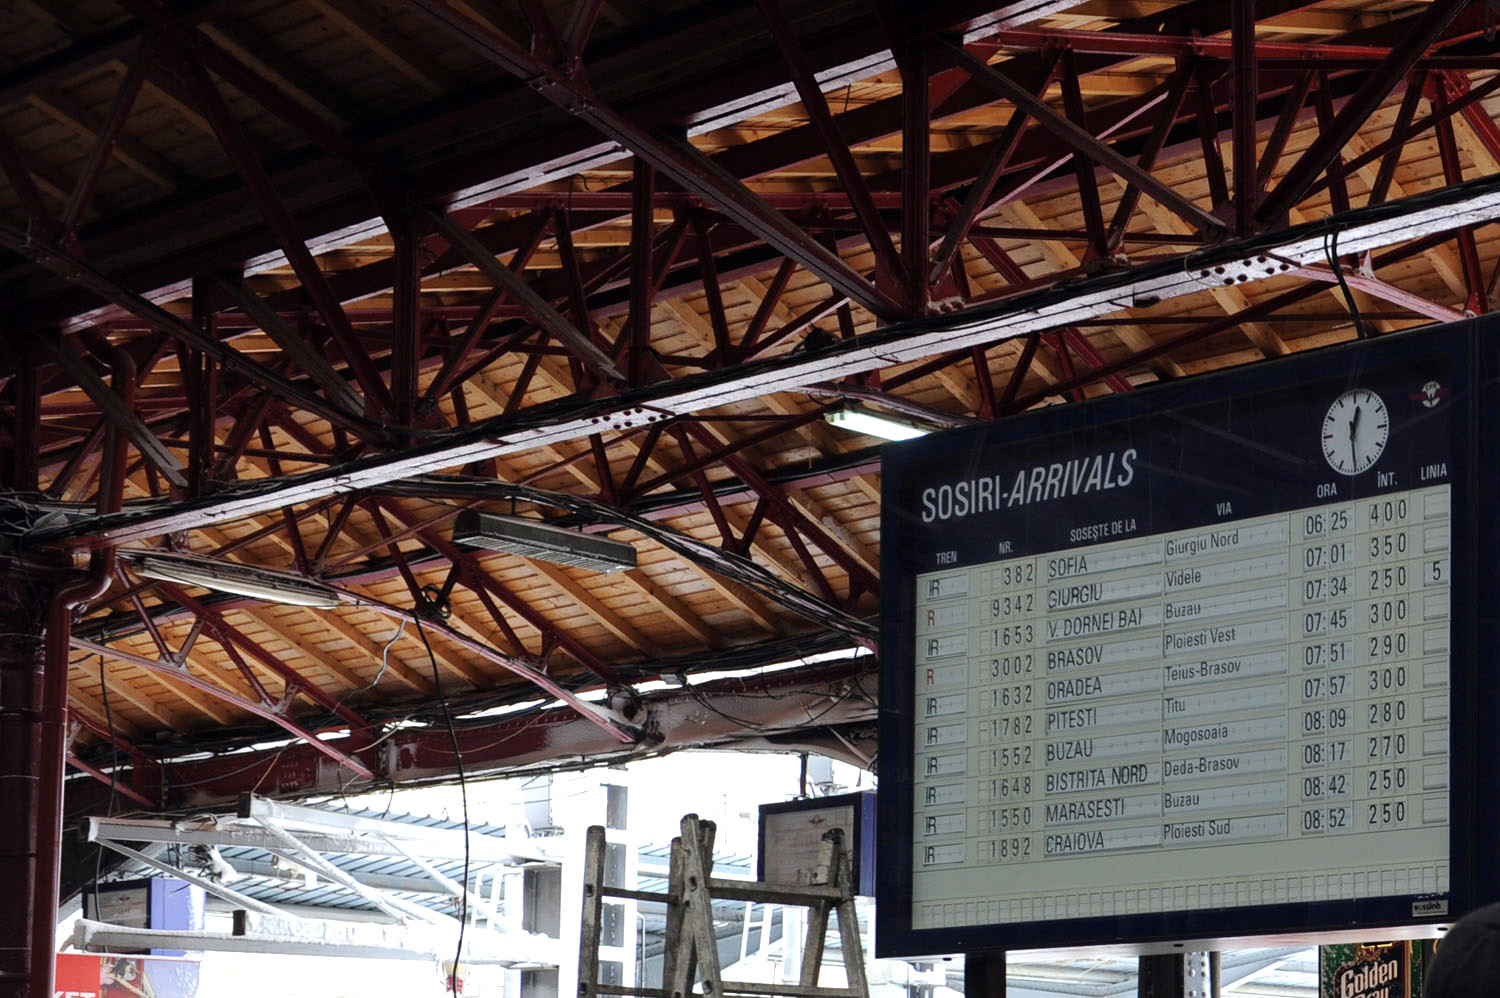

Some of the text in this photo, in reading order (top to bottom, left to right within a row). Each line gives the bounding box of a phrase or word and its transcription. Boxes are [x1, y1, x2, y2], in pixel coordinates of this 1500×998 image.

[921, 448, 1137, 523] SOSIRI-ARRIVALS
[936, 551, 957, 564] TREN
[1000, 542, 1013, 554] NR.
[1112, 520, 1124, 534] DE
[1126, 518, 1136, 531] LA
[1217, 502, 1232, 516] VIA
[1317, 483, 1337, 498] ORA
[1378, 472, 1398, 487] ÎNT.
[1421, 463, 1447, 480] LINIA
[1004, 564, 1033, 584] 382
[1049, 556, 1088, 577] SOFIA
[1166, 537, 1206, 556] Giurgiu
[1211, 530, 1239, 548] Nord
[993, 595, 1033, 617] 9342
[1049, 584, 1103, 608] GIURGIU
[1166, 569, 1201, 587] Videle
[993, 625, 1033, 646] 1653
[1050, 621, 1058, 637] V.
[1064, 614, 1114, 636] DORNEI
[1119, 609, 1142, 628] BAI
[1166, 602, 1200, 619] Buzau
[1432, 561, 1441, 580] 5
[992, 655, 1032, 677] 3002
[1049, 646, 1103, 669] BRASOV
[1166, 629, 1207, 650] Ploiesti
[1210, 628, 1235, 643] Vest
[993, 687, 1032, 707] 1632
[1048, 677, 1101, 699] ORADEA
[1165, 660, 1241, 681] Teius-Brasov
[993, 716, 1032, 736] 1782
[1048, 708, 1097, 730] PITESTI
[1166, 698, 1185, 713] Titu
[993, 747, 1031, 767] 1552
[1047, 740, 1093, 761] BUZAU
[1165, 723, 1228, 745] Mogosoaia
[992, 777, 1031, 796] 1648
[1047, 770, 1105, 792] BISTRITA
[1112, 764, 1147, 784] NORD
[1165, 757, 1239, 777] Deda-Brasov
[991, 807, 1031, 827] 1550
[1047, 799, 1125, 822] MARASESTI
[1165, 793, 1199, 808] Buzau
[991, 838, 1030, 857] 1892
[1046, 831, 1104, 853] CRAIOVA
[1164, 822, 1205, 839] Ploiesti
[1209, 820, 1230, 836] Sud
